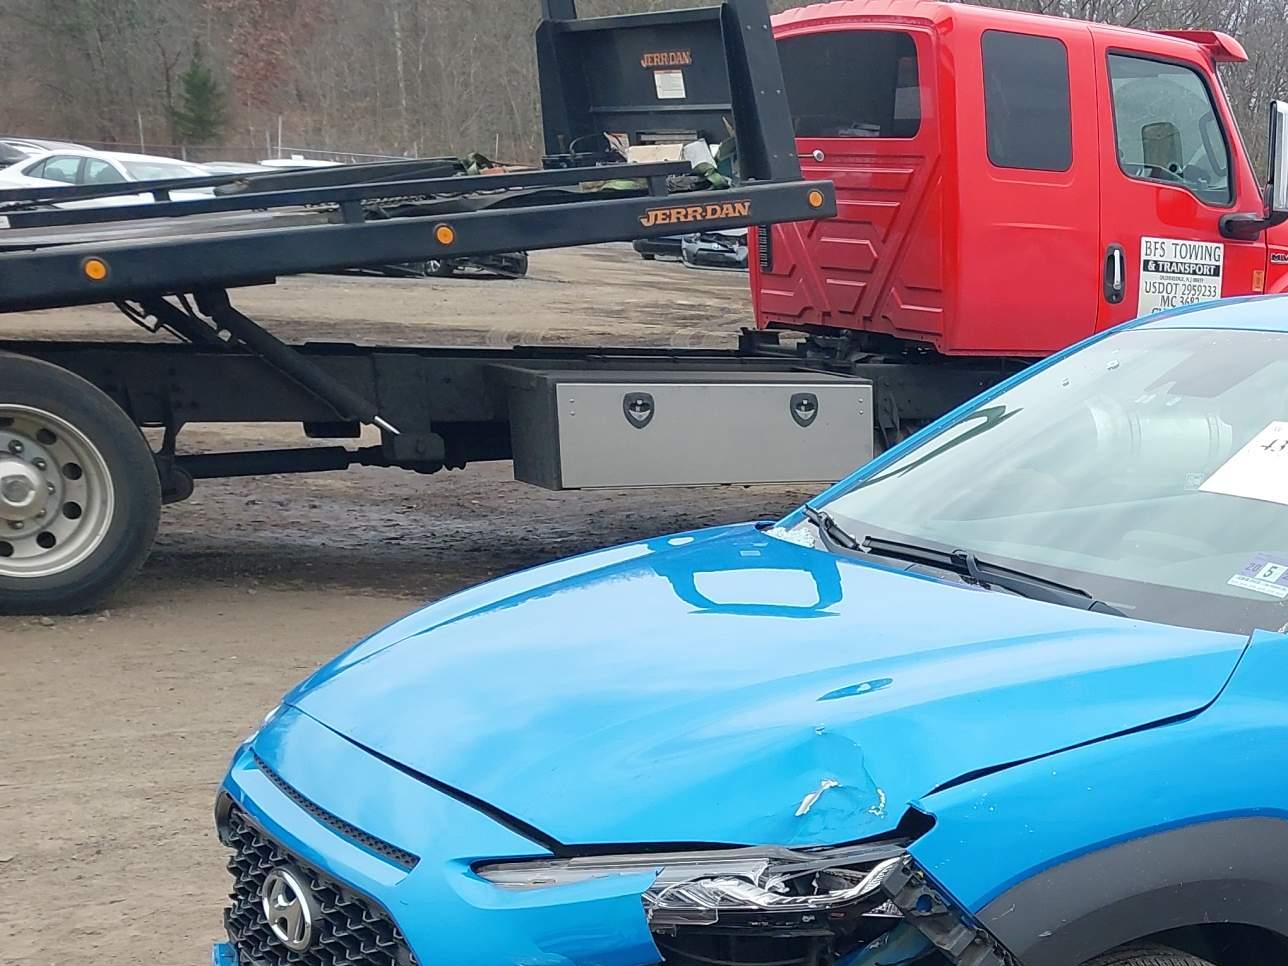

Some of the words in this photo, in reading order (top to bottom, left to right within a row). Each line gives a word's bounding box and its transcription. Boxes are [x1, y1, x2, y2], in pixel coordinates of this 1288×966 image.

[1145, 240, 1166, 258] BFS
[1172, 243, 1221, 262] TOWING
[1147, 260, 1156, 271] &
[1158, 261, 1216, 275] TRANSPORT
[1144, 281, 1179, 295] USDOT
[1181, 283, 1217, 298] 2959233
[1160, 295, 1177, 307] MC
[1263, 565, 1278, 578] 5
